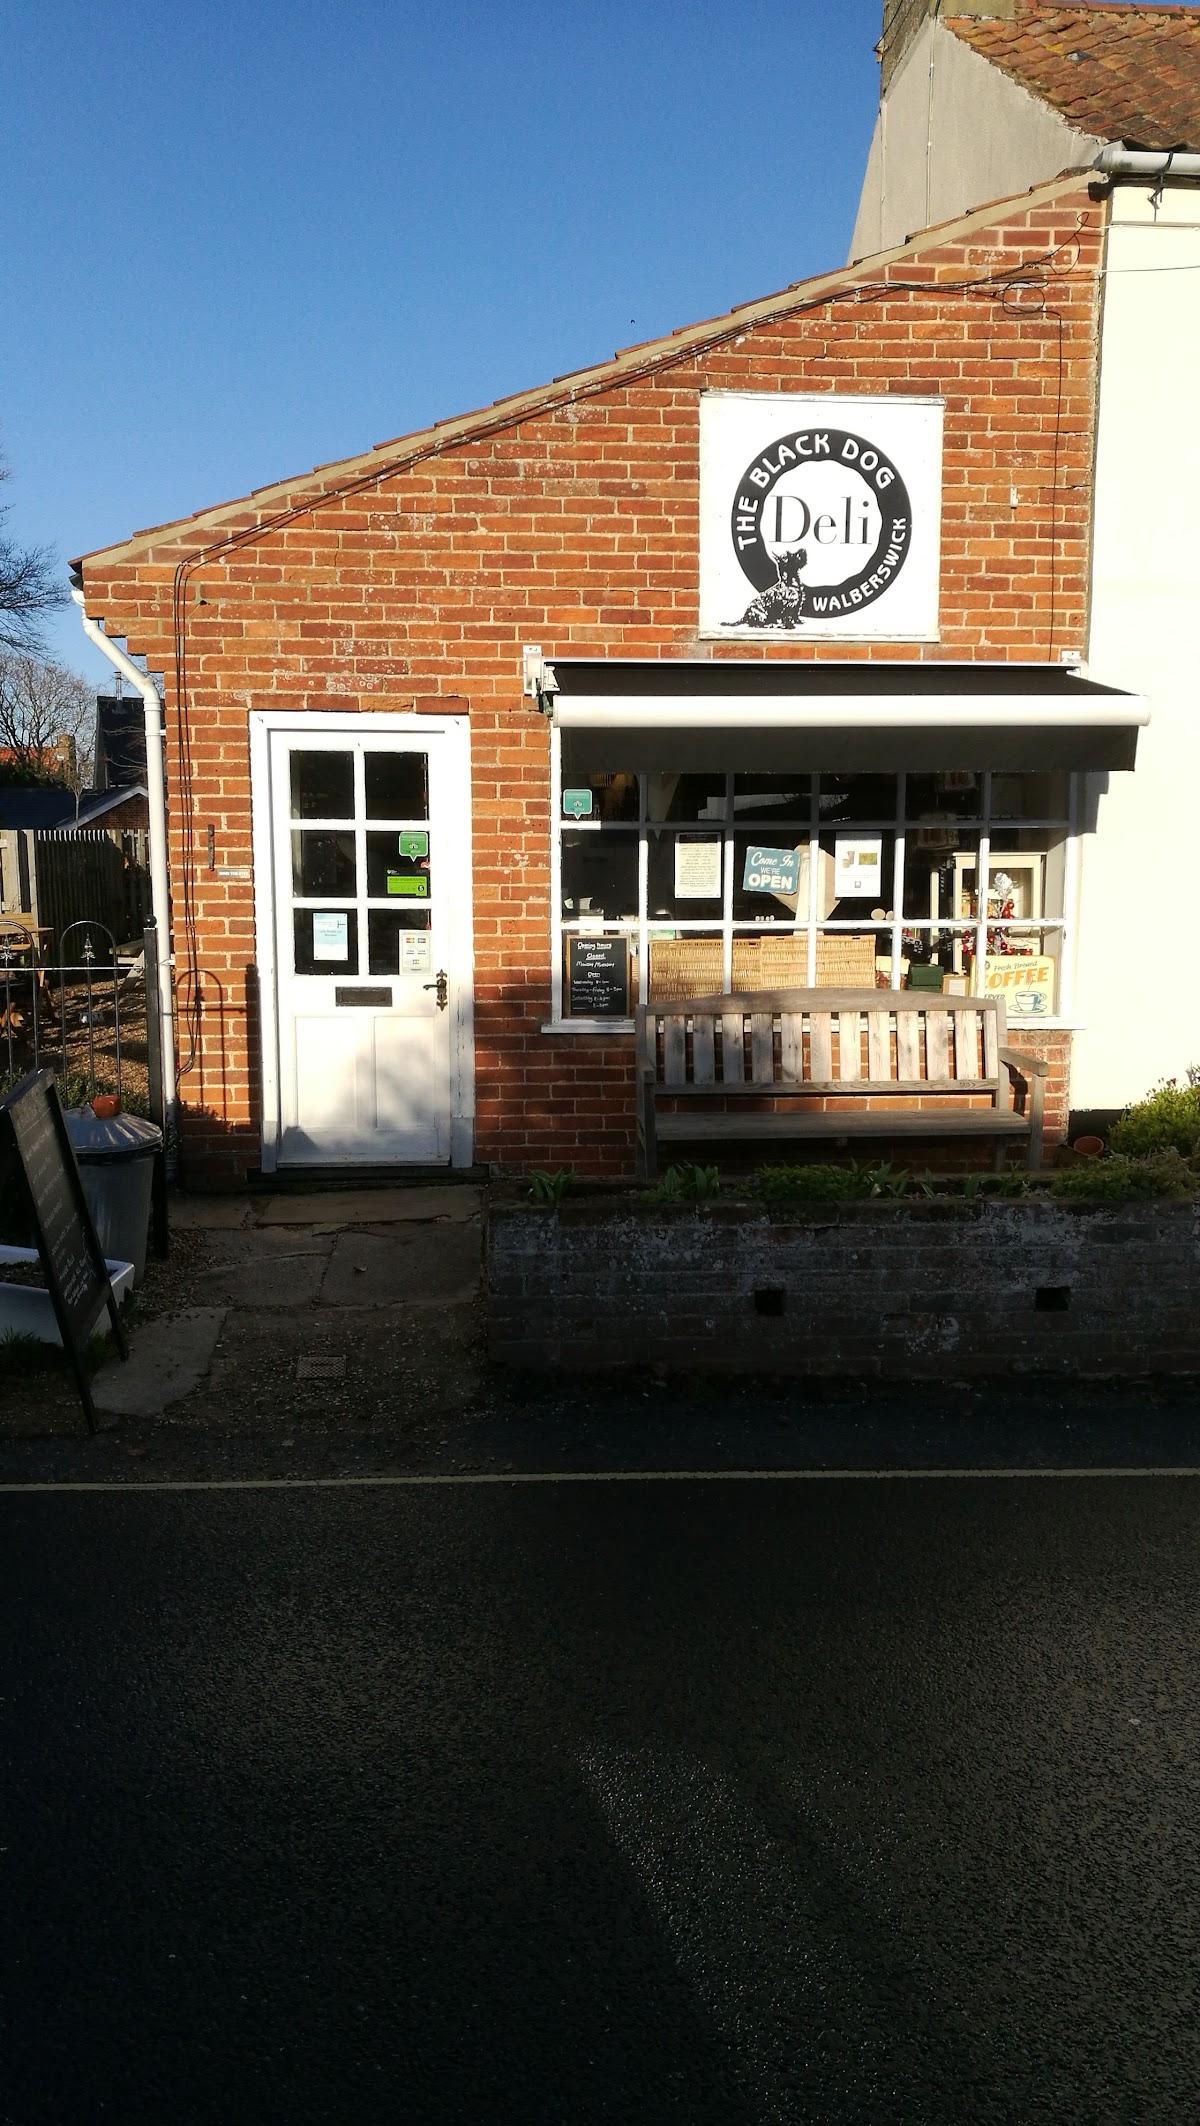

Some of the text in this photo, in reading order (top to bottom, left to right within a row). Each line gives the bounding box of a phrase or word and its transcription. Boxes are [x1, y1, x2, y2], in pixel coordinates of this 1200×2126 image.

[736, 433, 896, 551] THE BLACK DOG
[769, 495, 872, 545] Deli
[812, 517, 907, 612] WALBERSWICK
[751, 852, 794, 867] Come In
[748, 873, 793, 890] OPEN
[985, 966, 1050, 989] OFFEE
